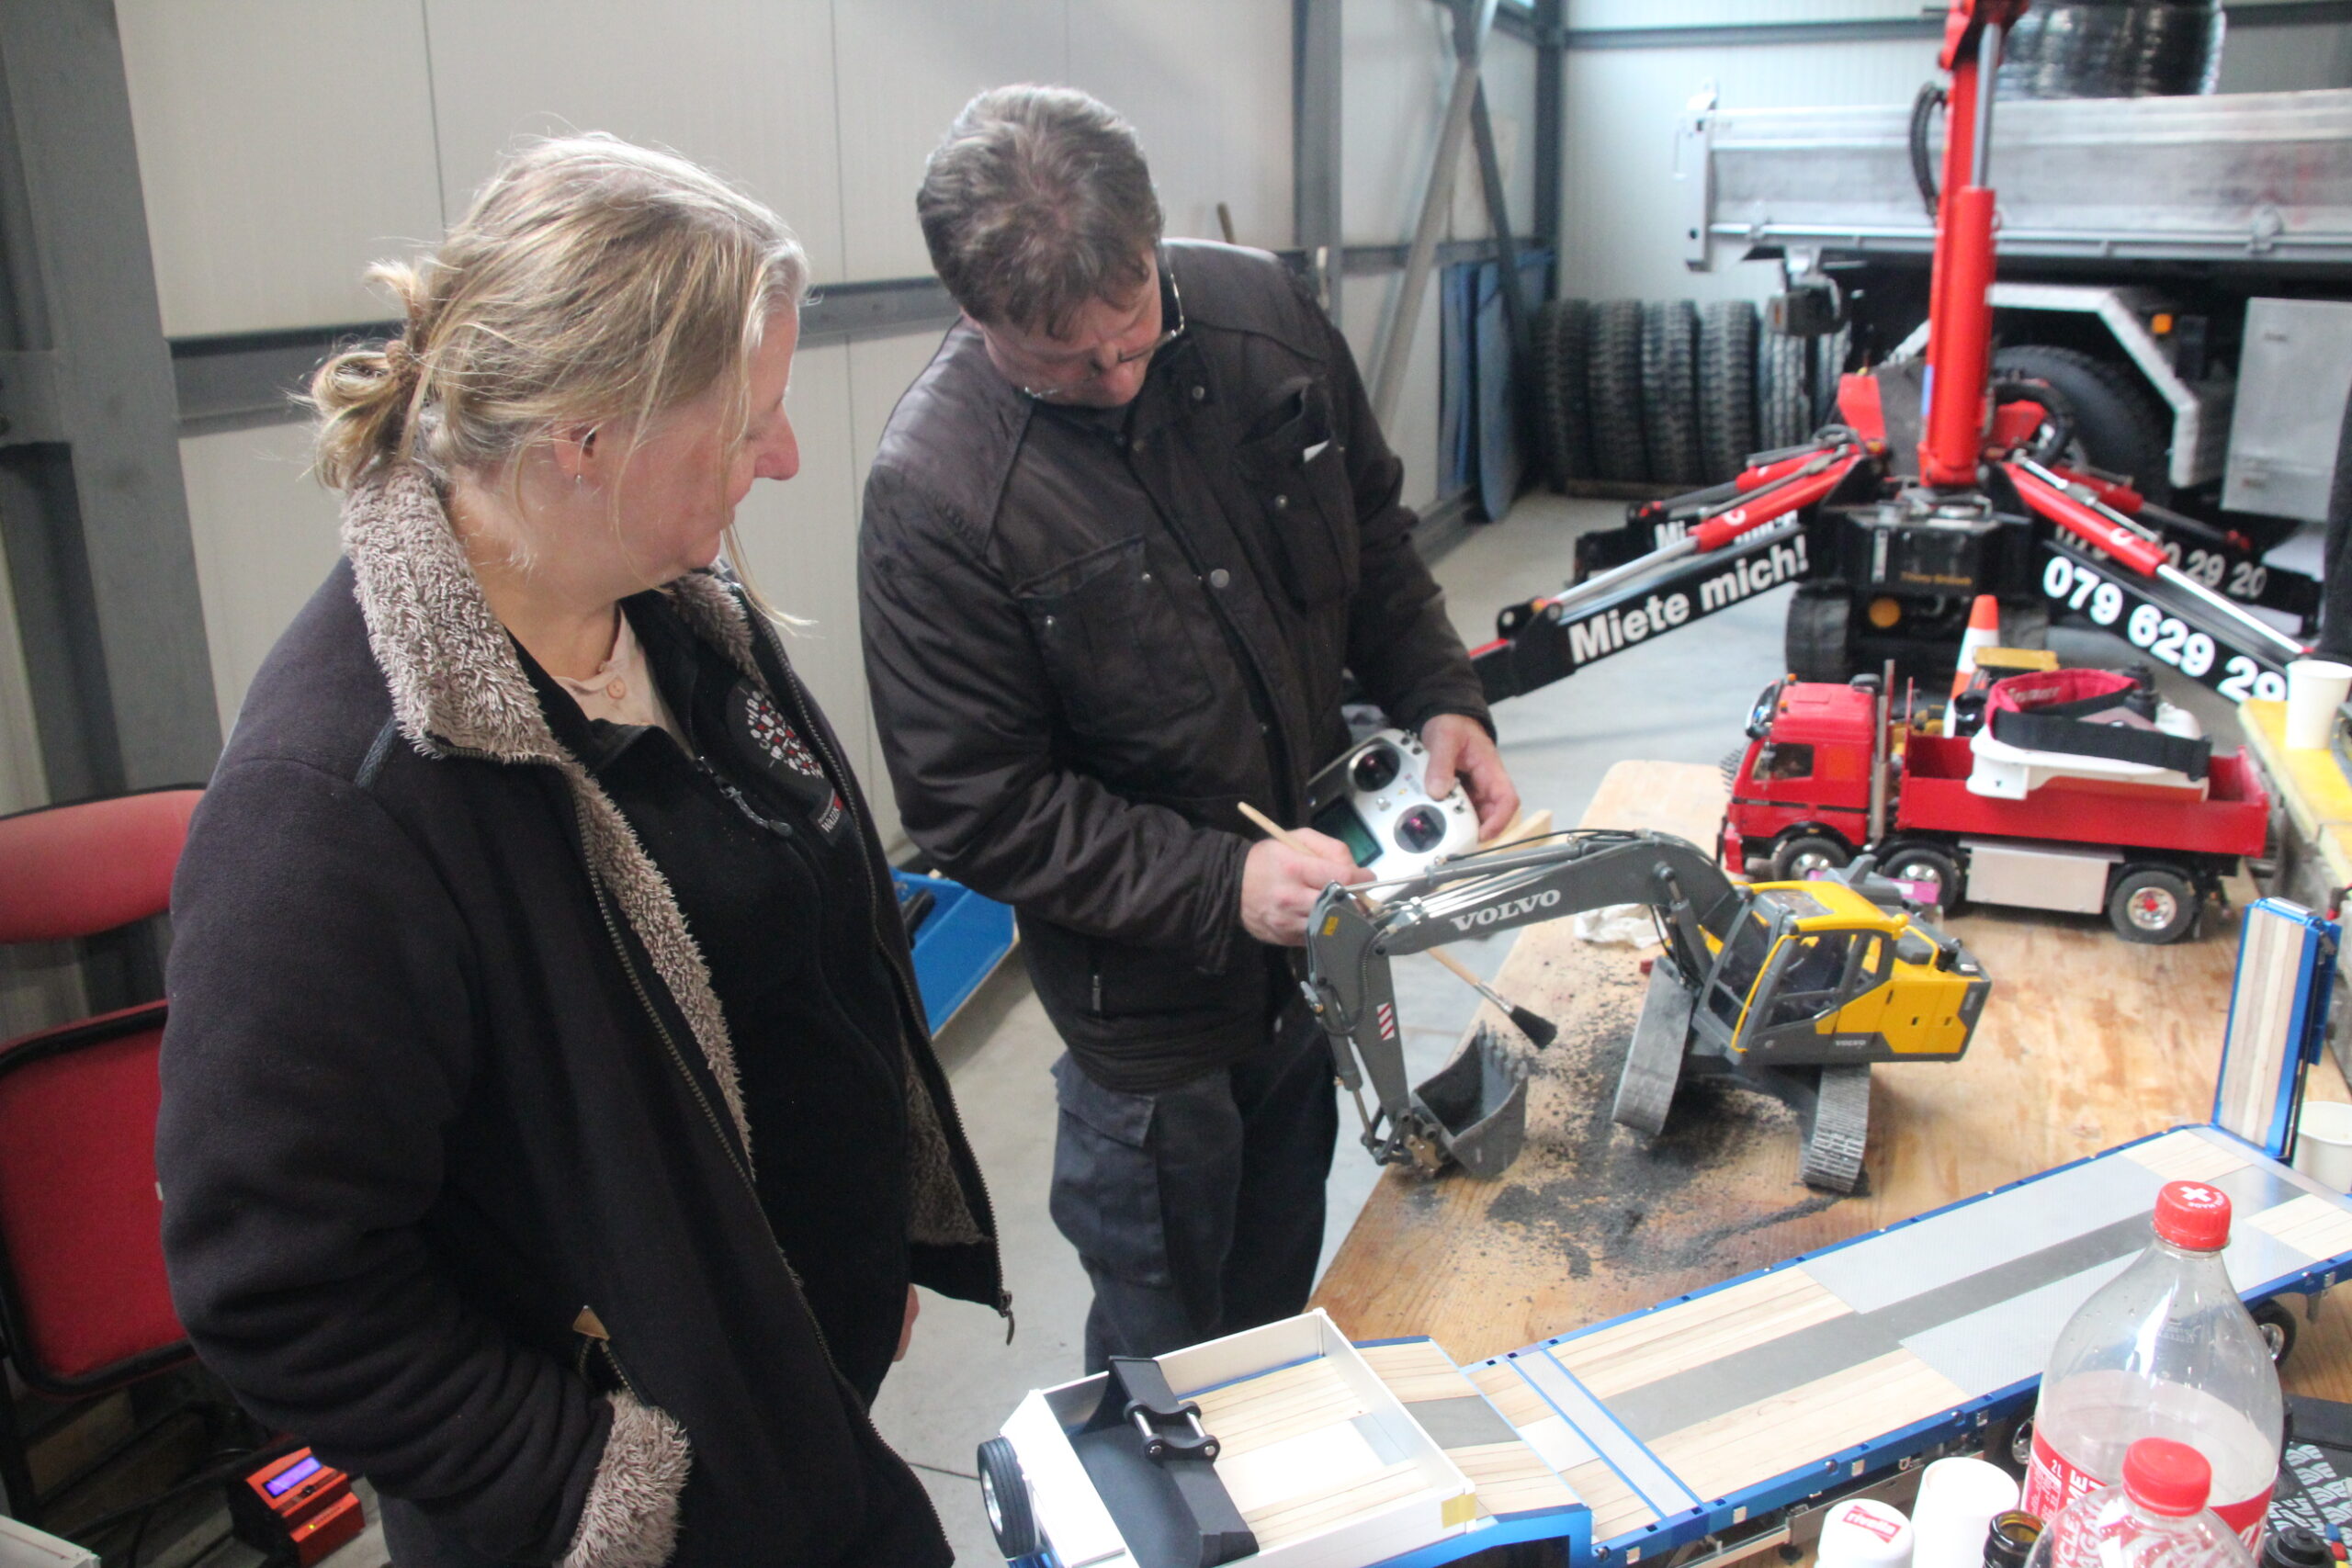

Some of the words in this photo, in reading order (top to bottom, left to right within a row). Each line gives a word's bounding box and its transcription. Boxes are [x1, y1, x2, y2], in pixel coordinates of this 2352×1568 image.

[1568, 592, 1690, 664] Miete
[1700, 535, 1809, 612] mich!
[2043, 556, 2123, 626] 079
[2128, 604, 2215, 677] 629
[2227, 561, 2267, 597] 20
[1450, 889, 1561, 931] VOLVO
